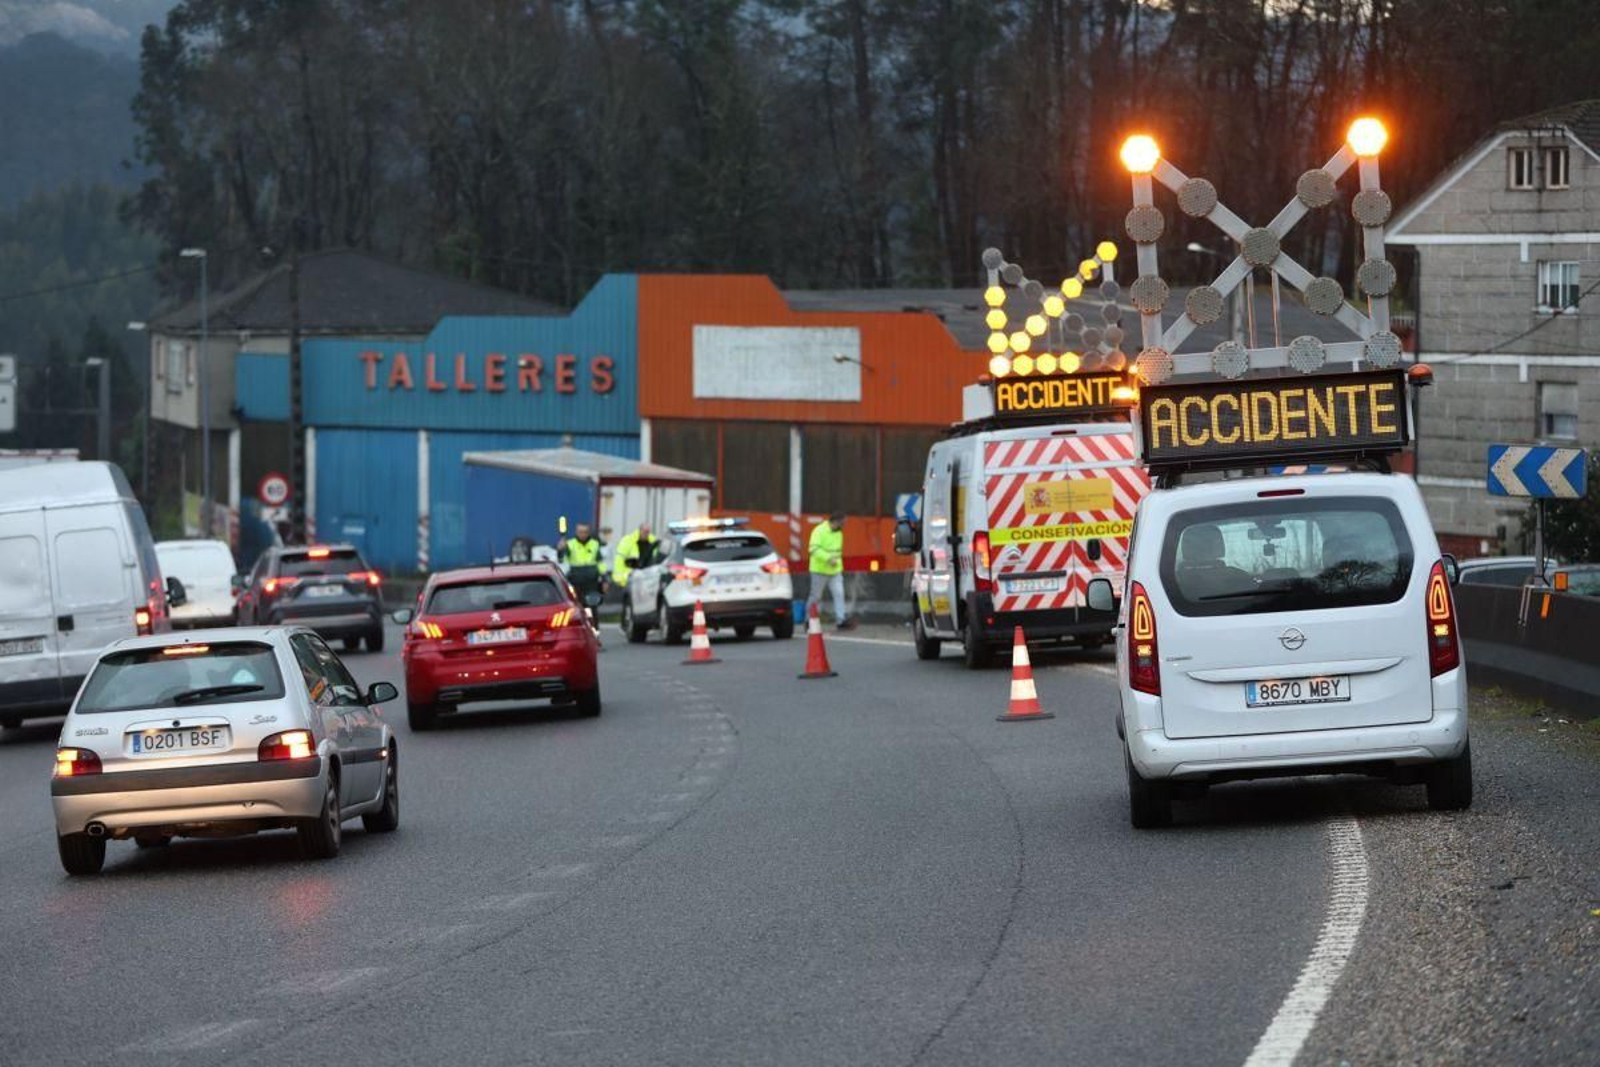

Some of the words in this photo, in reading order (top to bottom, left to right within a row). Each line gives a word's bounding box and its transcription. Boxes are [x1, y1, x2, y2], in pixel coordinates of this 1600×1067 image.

[360, 353, 615, 393] TALLERES
[1150, 382, 1396, 449] ACCIDENTE
[1011, 521, 1132, 541] CONSERVACIÓN
[1260, 683, 1302, 701] 8670
[1309, 679, 1341, 698] MBY
[143, 732, 185, 751] 0201
[191, 728, 221, 747] BSF
